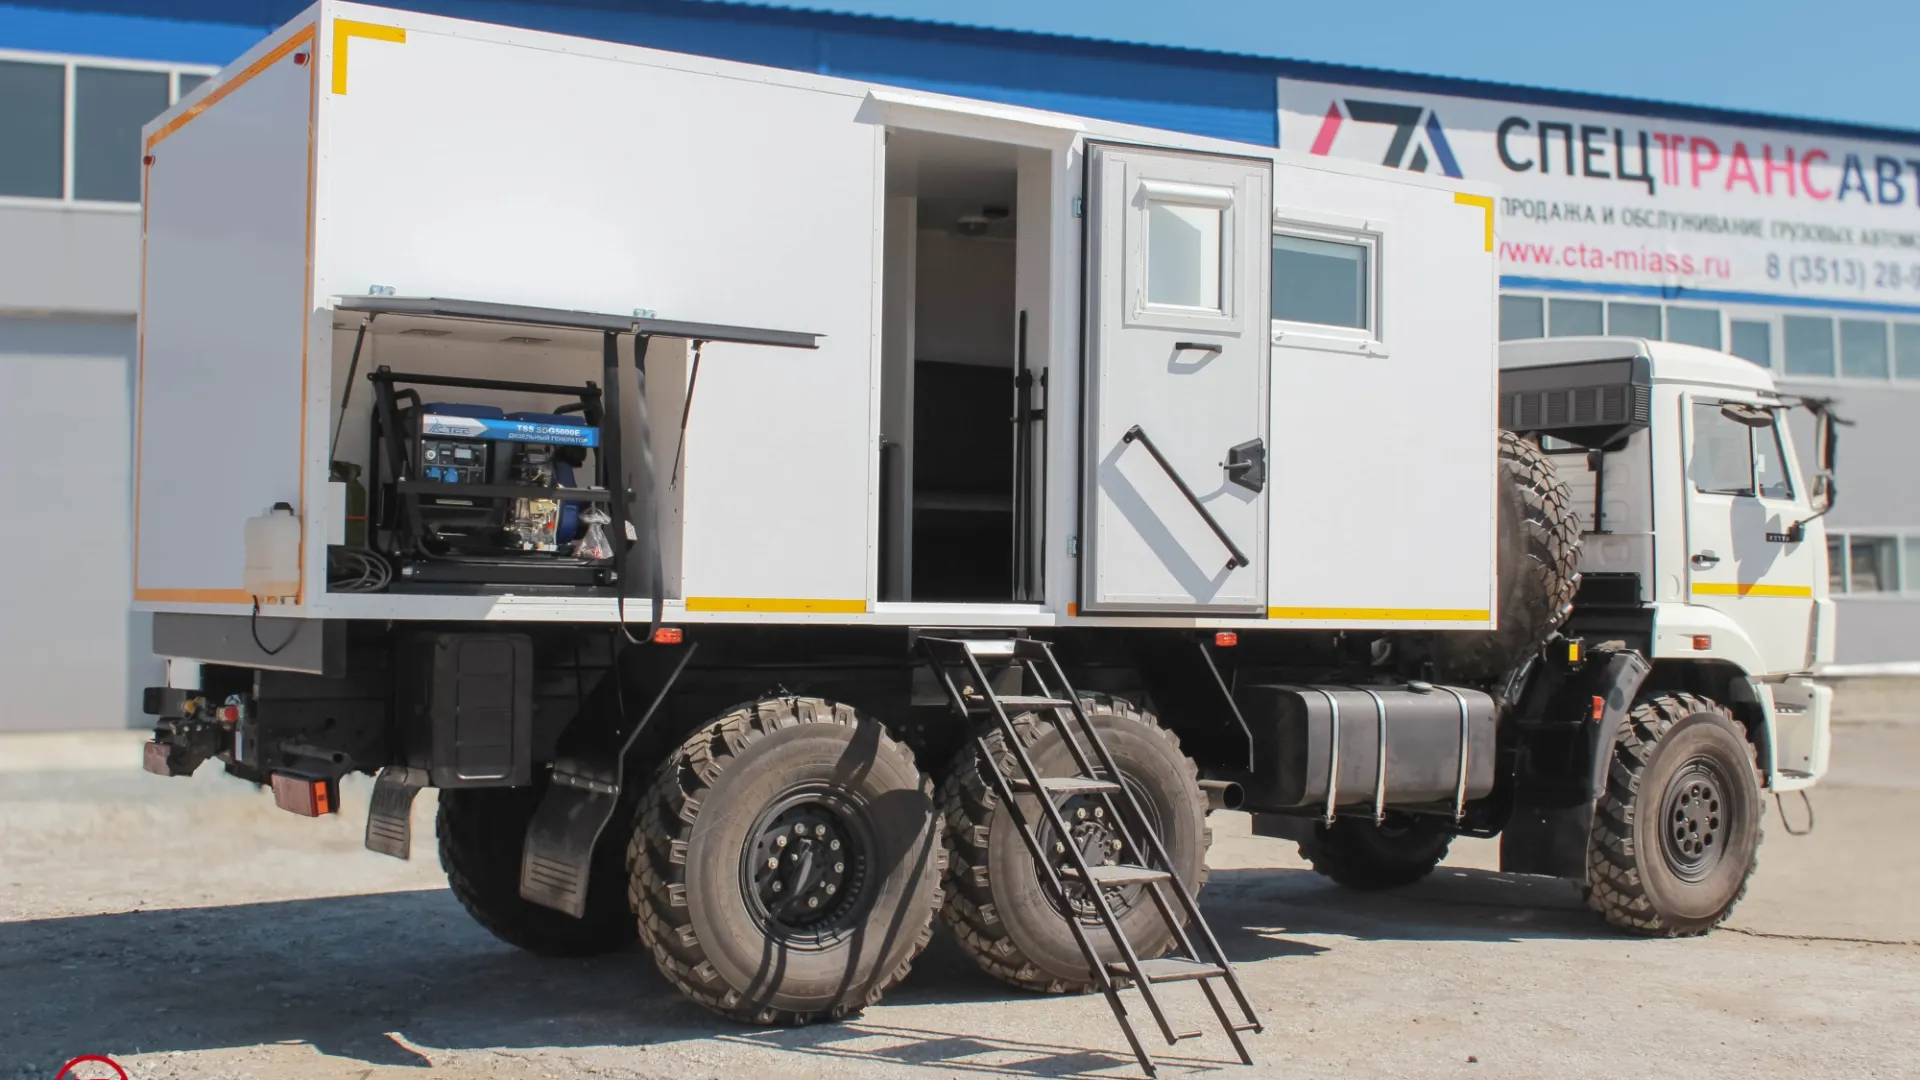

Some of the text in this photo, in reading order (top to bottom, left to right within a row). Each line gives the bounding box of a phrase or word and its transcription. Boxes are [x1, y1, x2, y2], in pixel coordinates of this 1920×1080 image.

[1501, 197, 1596, 224] ПРОДАЖА
[1602, 206, 1614, 225] И
[1621, 208, 1763, 237] ОБСЛУЖИВАНИЕ
[1766, 252, 1781, 281] 8
[1789, 254, 1866, 292] (3513)
[508, 432, 588, 444] ДИЗЕЛЬНЫЙ ГЕНЕРАТОР
